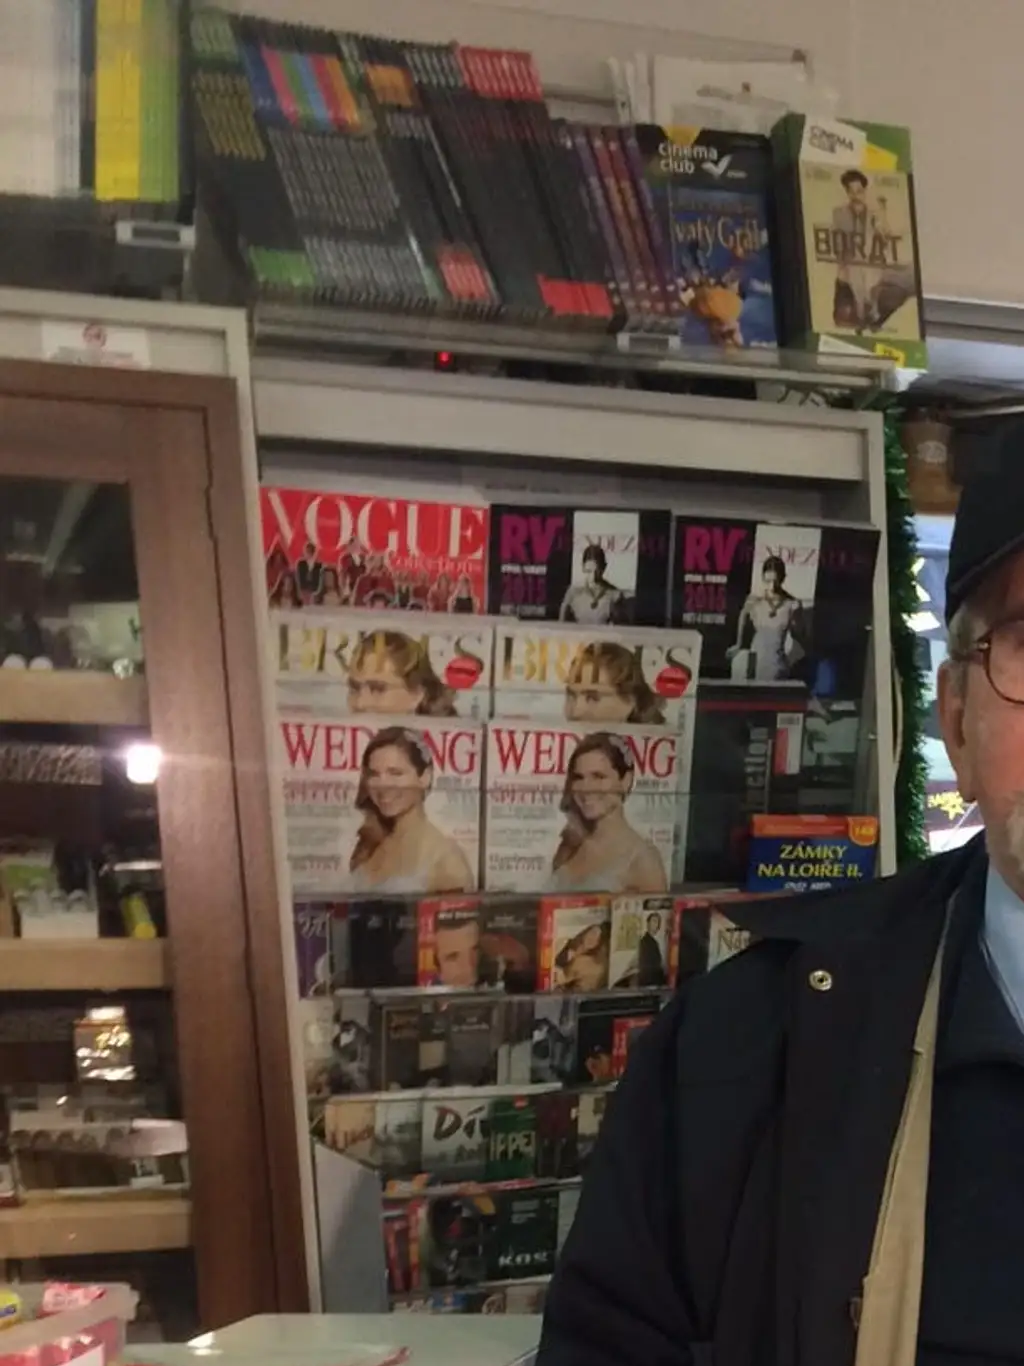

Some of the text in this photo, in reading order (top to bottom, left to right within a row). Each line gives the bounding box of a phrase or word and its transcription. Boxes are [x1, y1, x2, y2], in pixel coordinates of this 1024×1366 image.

[658, 142, 718, 161] cinema
[660, 156, 696, 174] club
[813, 226, 902, 264] BORAT
[267, 489, 486, 560] VOGUE
[281, 722, 478, 775] WEDNG
[493, 727, 677, 779] WEDNG
[780, 839, 848, 859] ZÁMKY
[758, 863, 785, 878] NA
